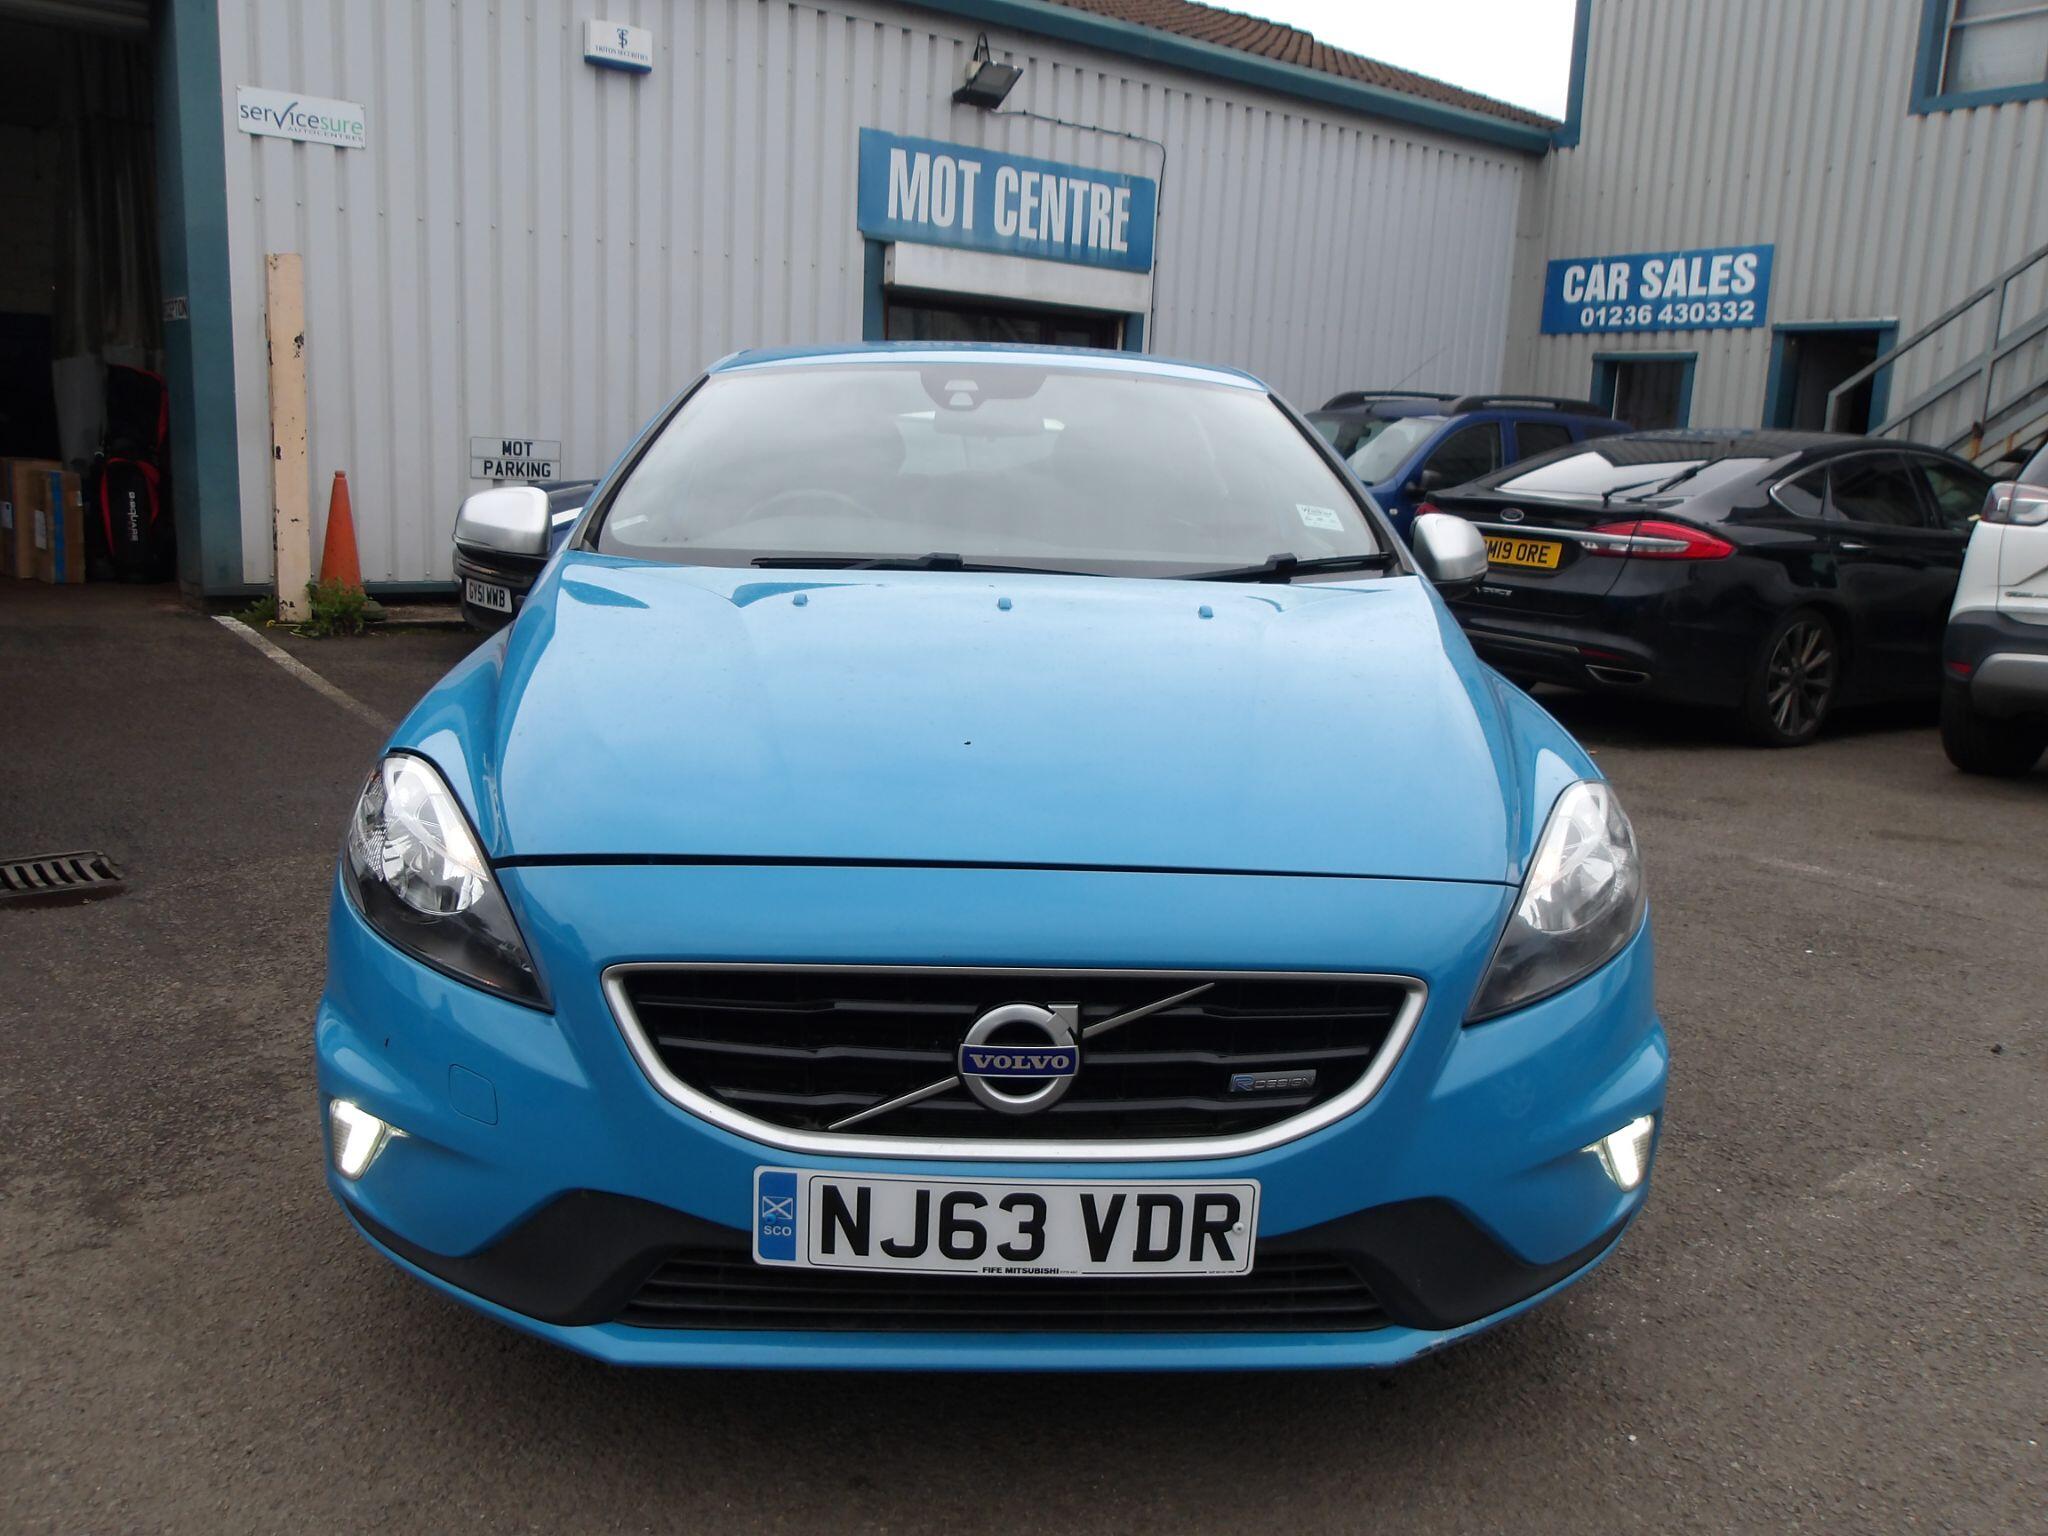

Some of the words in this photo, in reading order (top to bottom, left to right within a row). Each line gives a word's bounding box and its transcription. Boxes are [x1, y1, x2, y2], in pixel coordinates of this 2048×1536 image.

[240, 101, 363, 135] servicesure
[887, 147, 981, 230] MOT
[994, 165, 1131, 252] CENTRE
[1562, 262, 1631, 304] CAR
[1639, 253, 1758, 299] SALES
[1580, 304, 1653, 327] 01236
[1657, 300, 1755, 324] 430332
[502, 440, 533, 457] MOT
[484, 460, 551, 478] PARKING
[1484, 539, 1513, 560] M19
[1515, 543, 1551, 564] ORE
[969, 1053, 1070, 1070] VOLVO
[763, 1225, 792, 1237] SCO
[821, 1184, 1047, 1262] NJ63
[1080, 1193, 1241, 1263] VDR
[982, 1266, 1003, 1274] FIFE
[1004, 1267, 1060, 1275] MITSUBISHI
